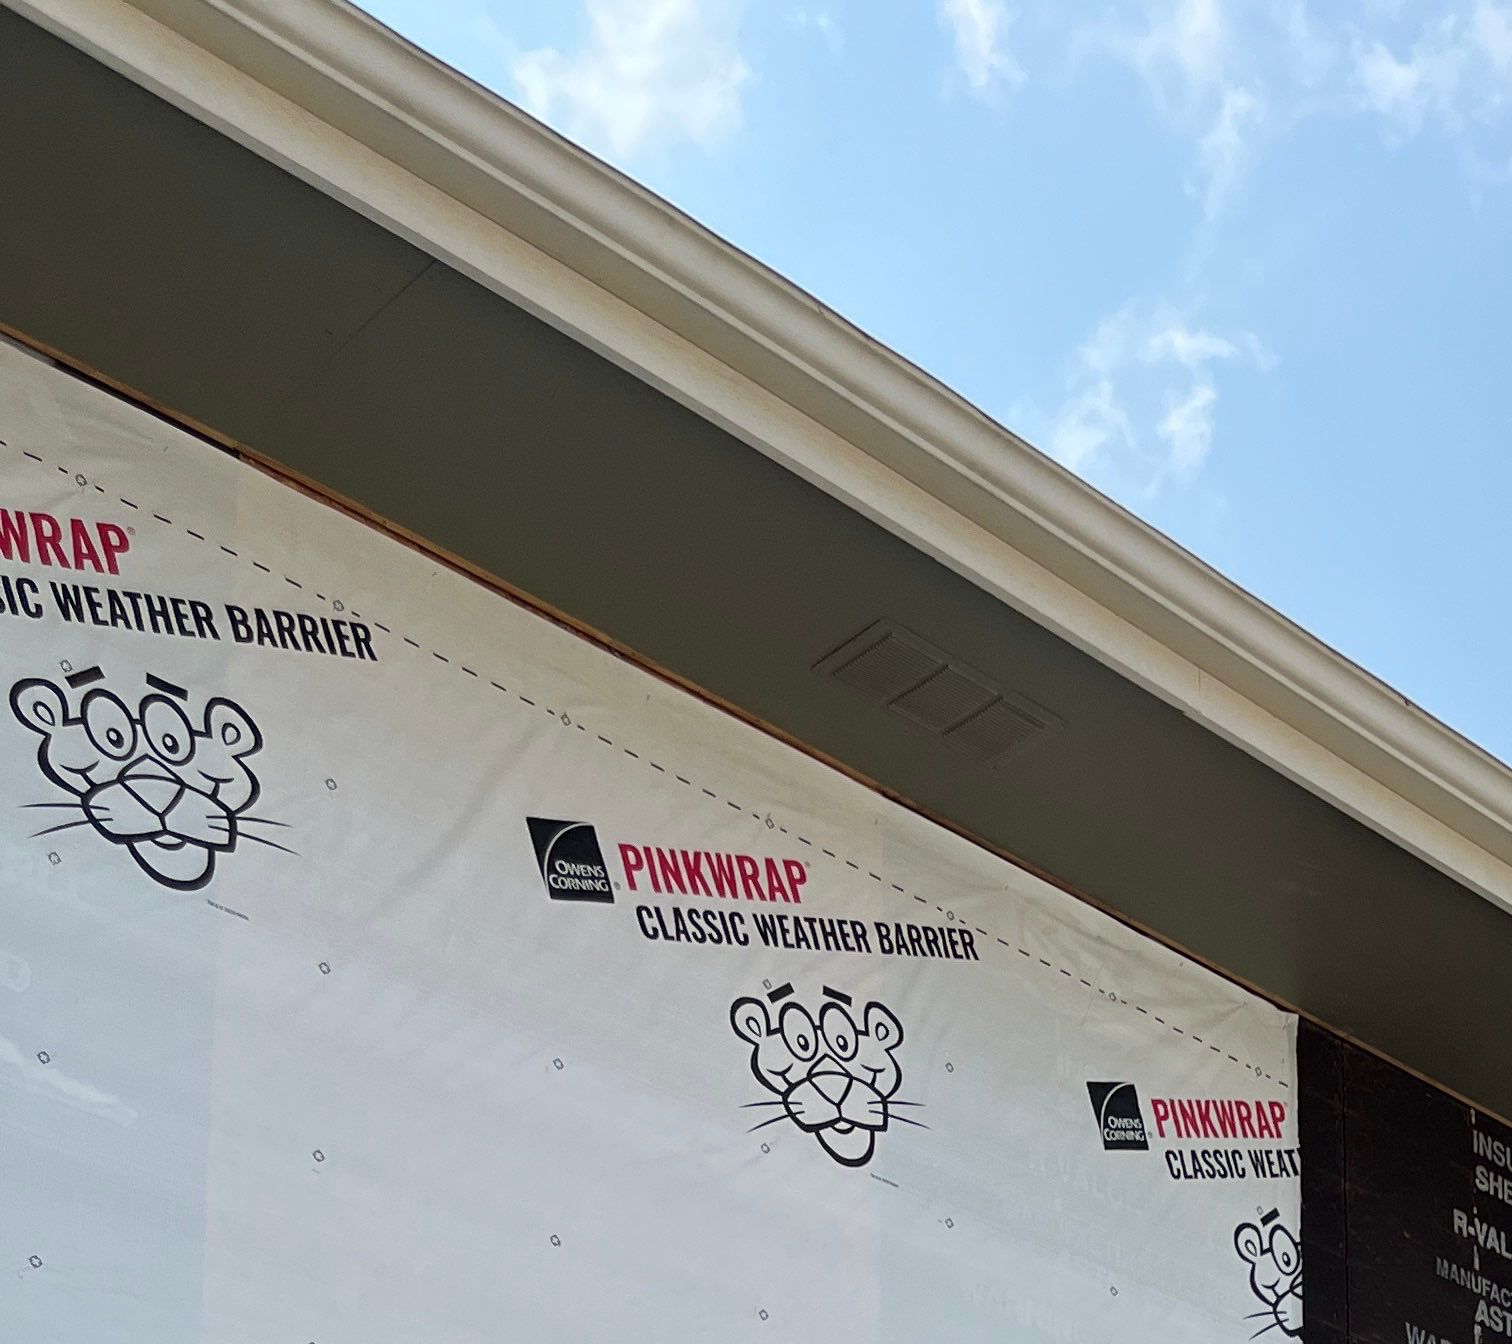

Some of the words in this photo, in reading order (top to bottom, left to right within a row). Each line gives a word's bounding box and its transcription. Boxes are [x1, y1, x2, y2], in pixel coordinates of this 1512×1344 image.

[0, 575, 44, 619] IC
[49, 580, 221, 641] WEATHER
[223, 604, 379, 662] BARRIER
[548, 874, 610, 893] CORNING
[554, 860, 606, 878] OWENS
[617, 842, 808, 903] PINKWRAP
[635, 905, 750, 947] CLASSIC
[753, 913, 873, 954] WEATHER
[873, 921, 980, 961] BARRIER
[1107, 1116, 1143, 1130] OWENS
[1150, 1098, 1287, 1139] PINKWRAP
[1104, 1129, 1146, 1142] CORNING
[1164, 1149, 1247, 1180] CLASSIC
